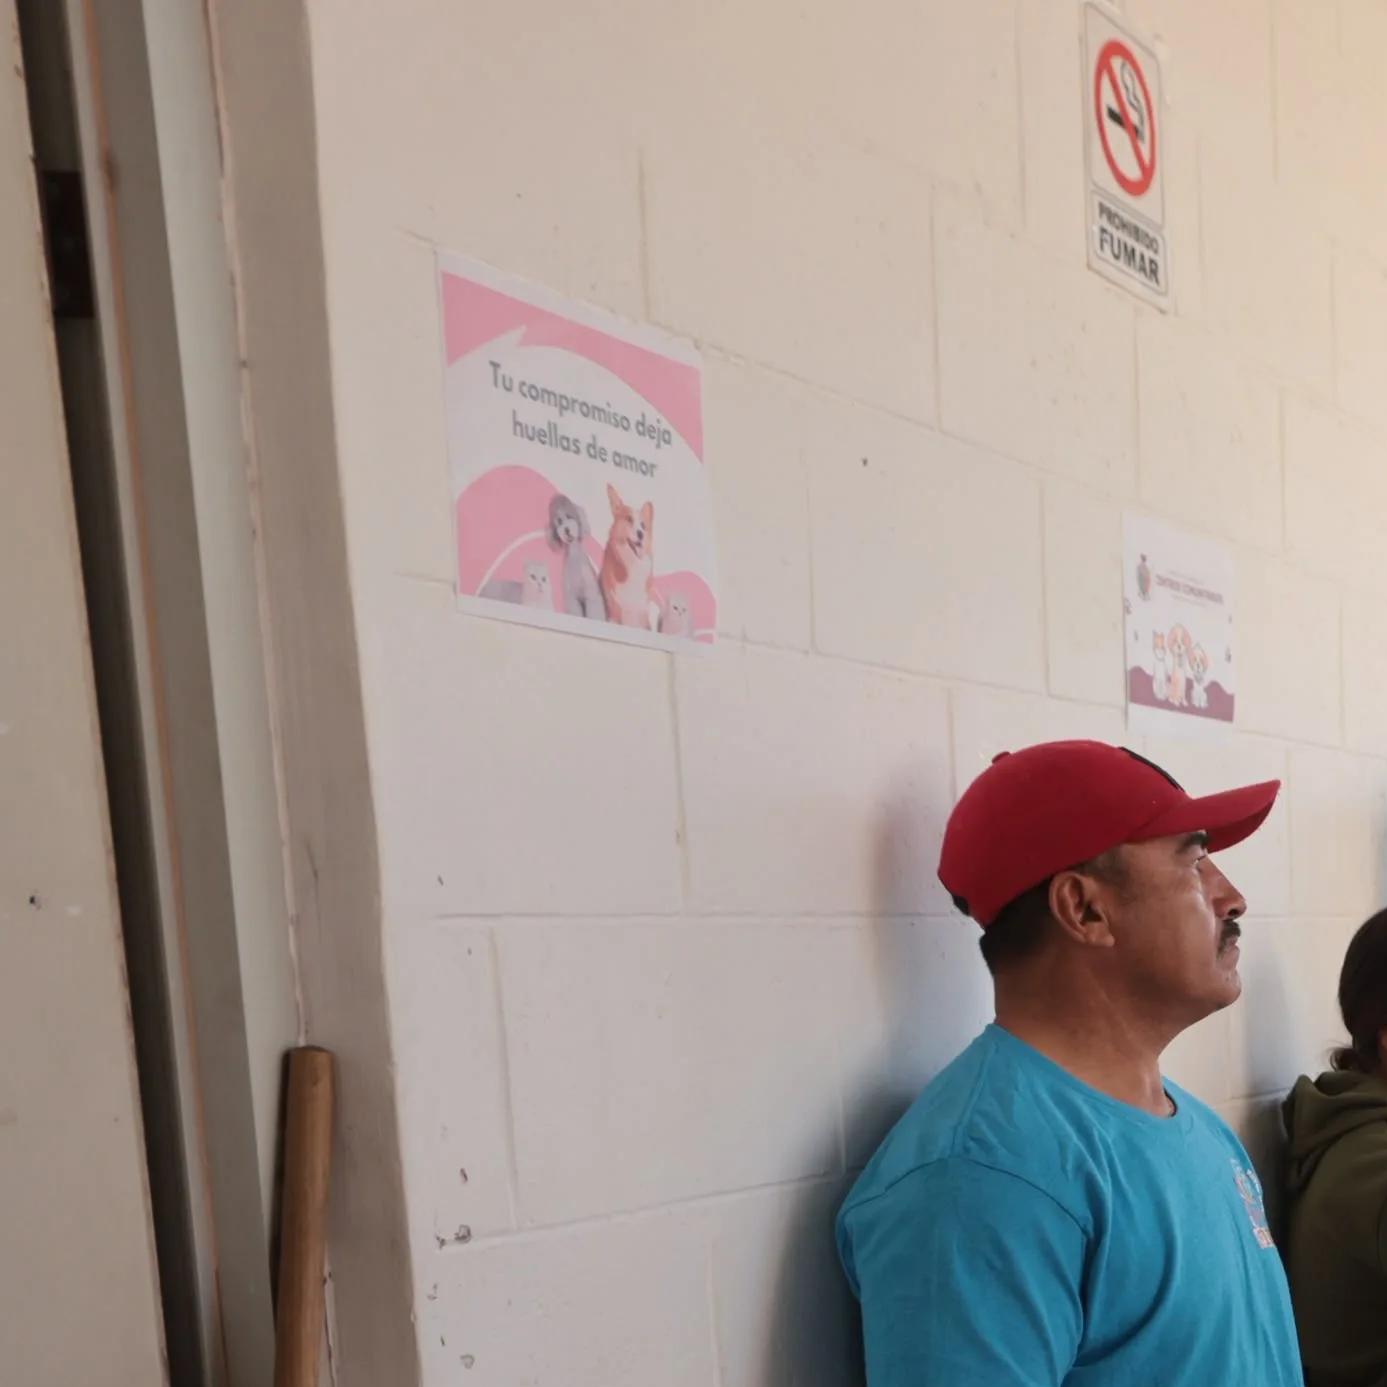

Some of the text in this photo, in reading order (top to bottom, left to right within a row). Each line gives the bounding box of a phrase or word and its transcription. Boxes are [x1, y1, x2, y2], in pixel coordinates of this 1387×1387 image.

[1098, 201, 1158, 255] PROHIBIDO
[1100, 226, 1160, 286] FUMAR
[489, 360, 672, 449] Tu compromiso deja
[511, 409, 658, 478] huellas de amor
